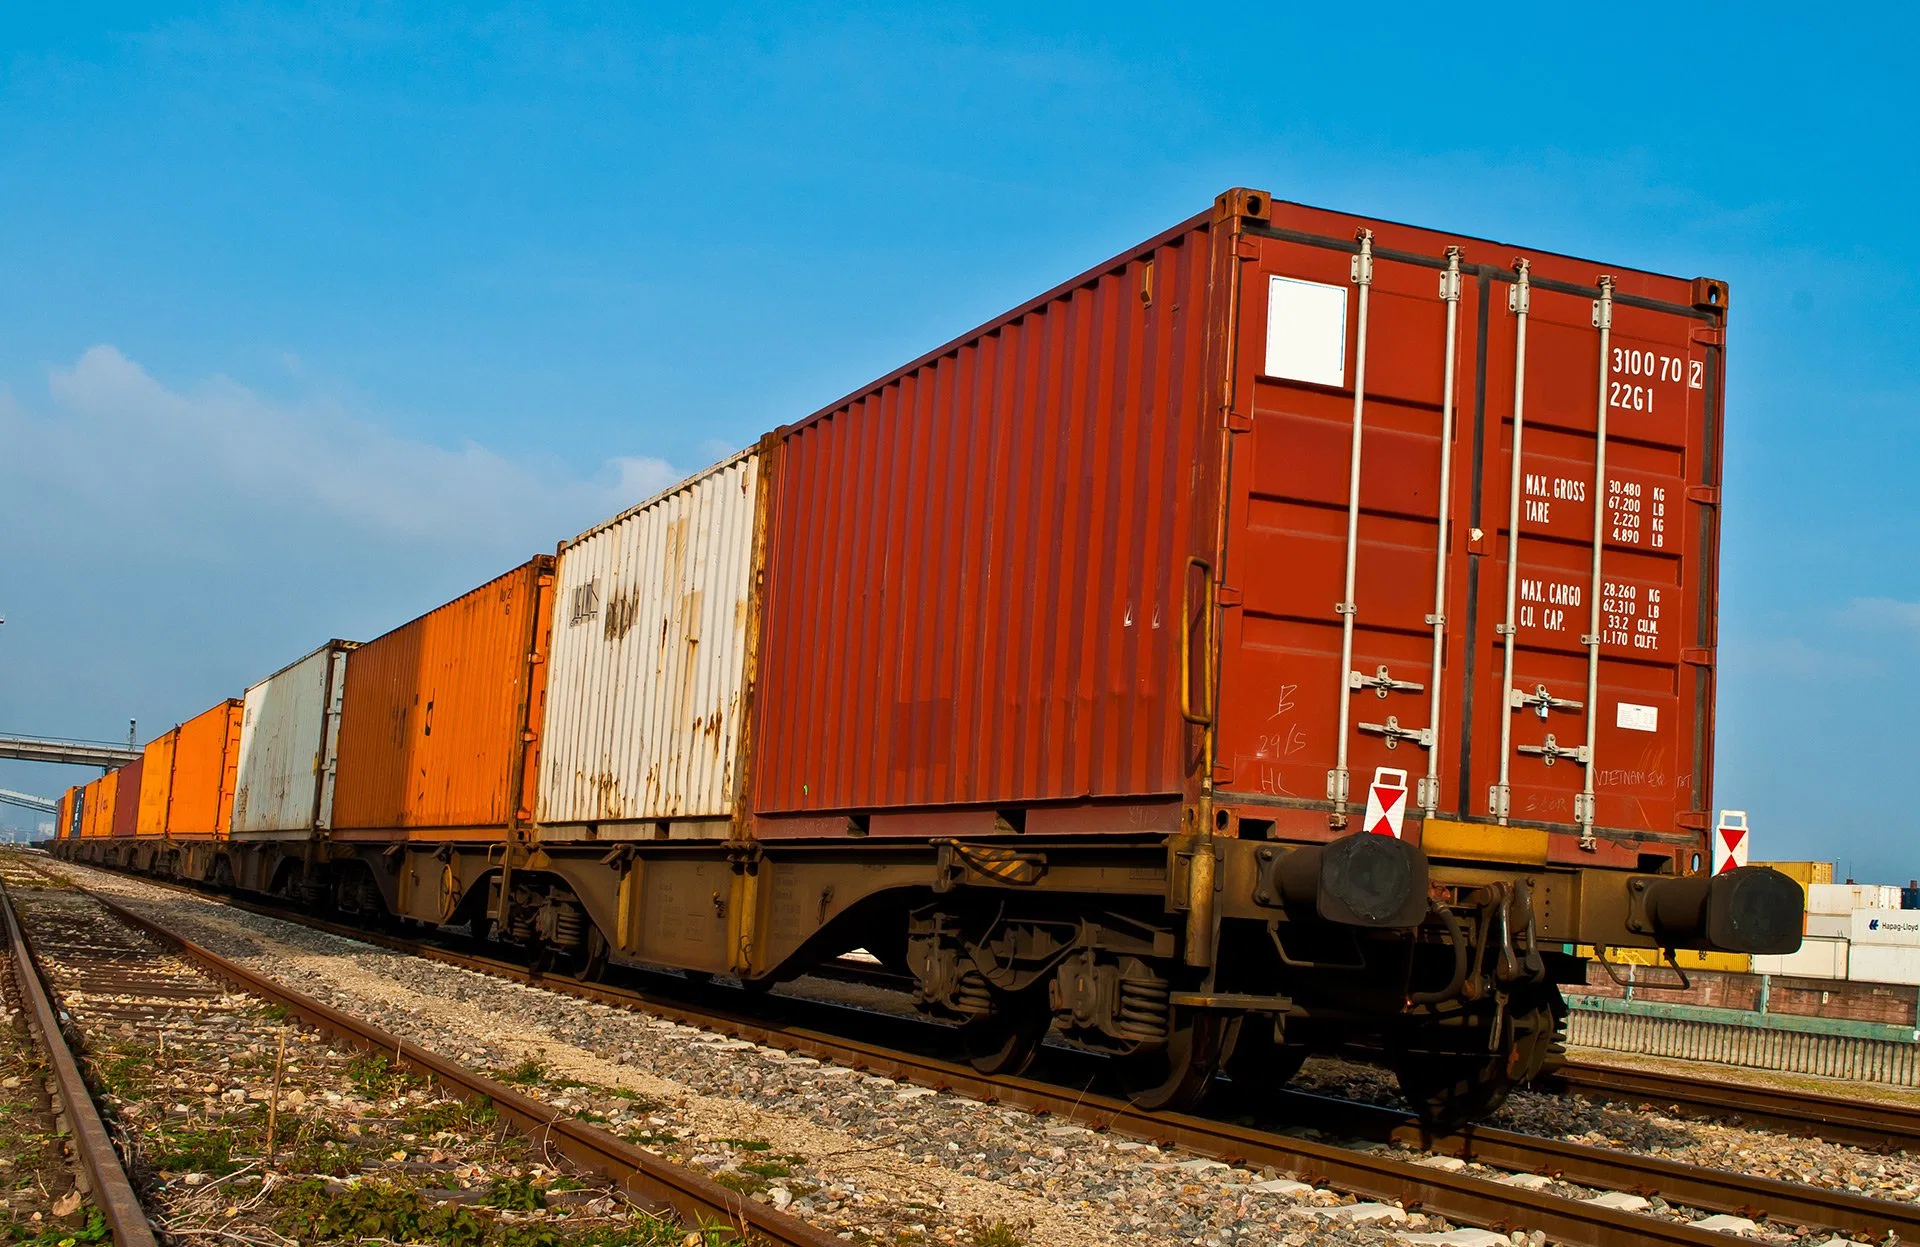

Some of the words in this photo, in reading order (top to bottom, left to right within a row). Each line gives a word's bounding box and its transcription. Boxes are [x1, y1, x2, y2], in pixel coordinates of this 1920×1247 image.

[1609, 381, 1653, 413] 22G1
[1525, 473, 1550, 498] MAX.
[1553, 477, 1585, 502] GROSS
[1609, 479, 1641, 498] 30.480
[1653, 486, 1665, 502] KG
[1525, 499, 1550, 524] TARE
[1613, 511, 1640, 529] 2.220
[1652, 517, 1664, 533] KG
[1608, 495, 1640, 513] 67.200
[1652, 502, 1665, 517] LB
[1612, 527, 1640, 544] 4.890
[1651, 533, 1664, 548] LB
[1521, 578, 1546, 604] MAX.
[1549, 582, 1581, 607] CARGO
[1603, 582, 1636, 600] 28.260
[1648, 588, 1661, 603] KG
[1520, 605, 1536, 628] CU.
[1543, 608, 1567, 632] CAP.
[1608, 614, 1629, 631] 33.2
[1602, 598, 1636, 616] 62.310
[1647, 604, 1660, 619] LB
[1603, 629, 1628, 646] 1.170
[1881, 921, 1919, 932] Hapag-Lloyd
